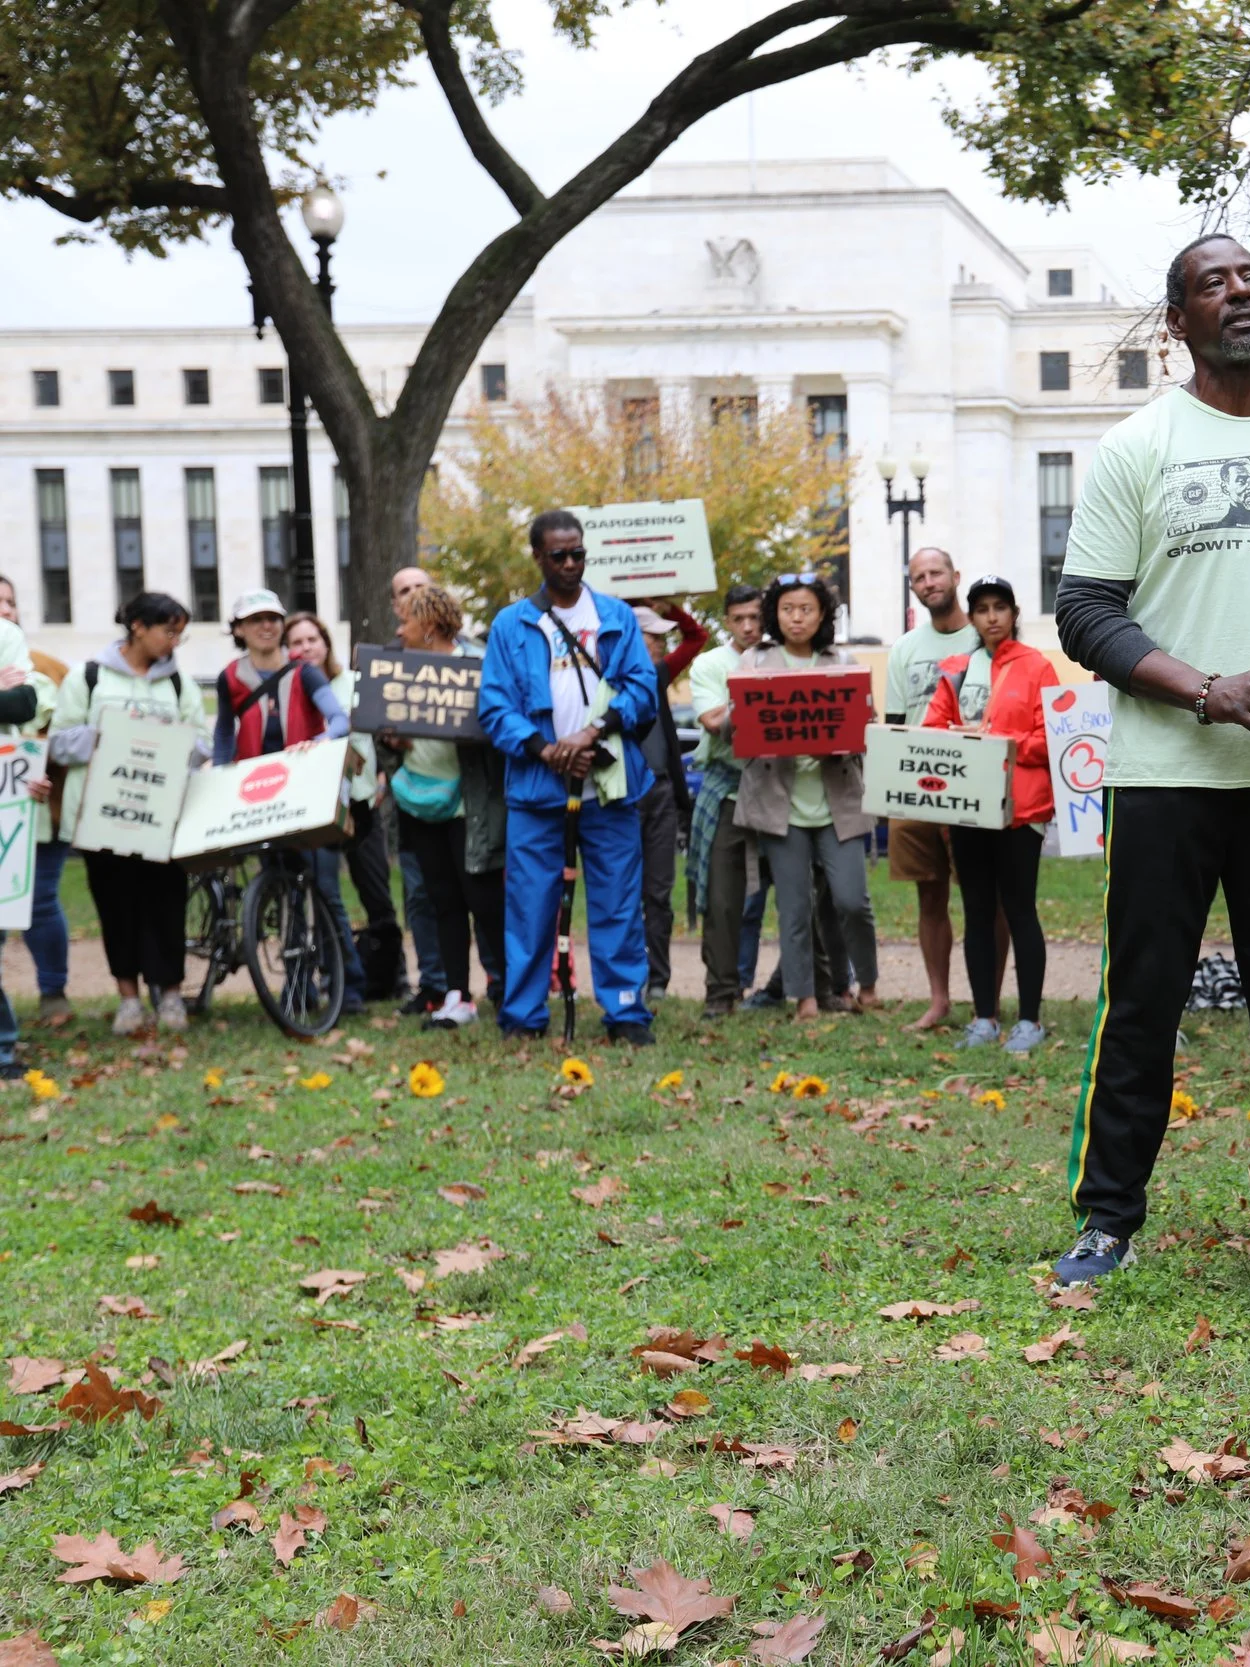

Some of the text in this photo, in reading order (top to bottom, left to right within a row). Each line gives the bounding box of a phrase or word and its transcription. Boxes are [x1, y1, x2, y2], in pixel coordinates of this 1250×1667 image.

[584, 514, 686, 530] GARDENING
[585, 550, 695, 567] DEFIANT ACT
[1167, 540, 1223, 558] GROW
[1227, 540, 1243, 550] IT
[370, 659, 482, 688] PLANT
[382, 681, 477, 709] SOME
[744, 687, 857, 706] PLANT
[386, 702, 470, 728] SHIT
[758, 707, 846, 724] SOME
[764, 725, 841, 742] SHIT
[1047, 716, 1078, 736] WE
[907, 745, 963, 759] TAKING
[111, 765, 167, 787] ARE
[899, 759, 968, 778] BACK
[243, 774, 286, 793] STOP
[921, 779, 946, 789] MY
[118, 787, 148, 802] THE
[886, 790, 980, 812] HEALTH
[100, 804, 162, 827] SOIL
[230, 801, 287, 822] FOOD
[204, 808, 308, 839] INJUSTICE
